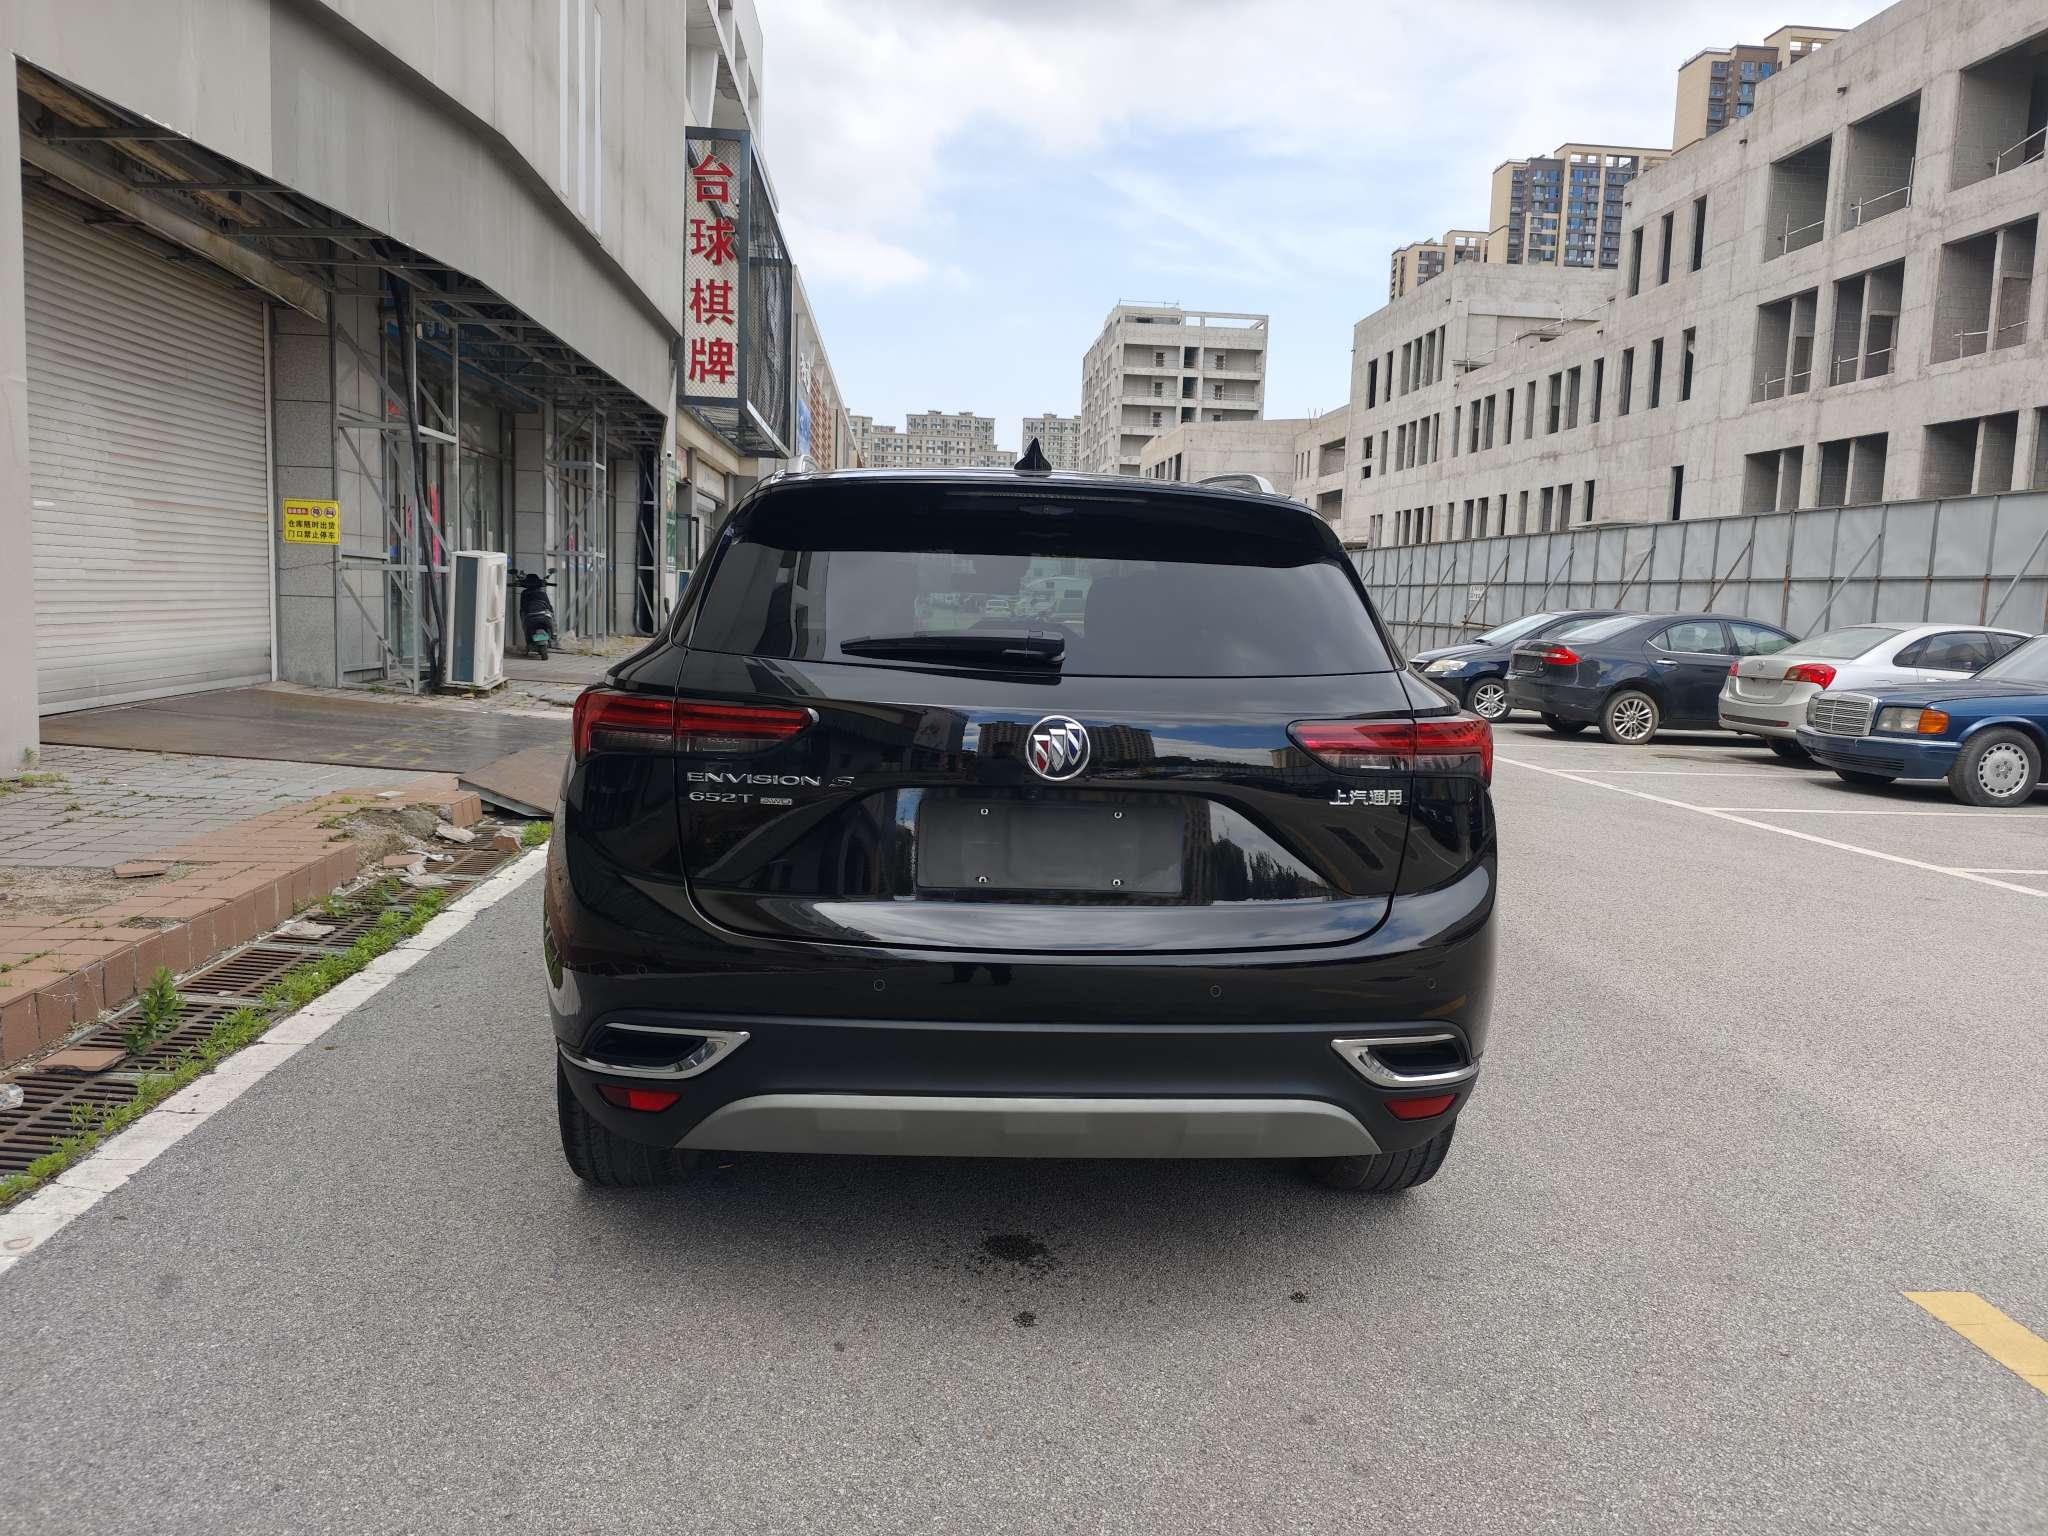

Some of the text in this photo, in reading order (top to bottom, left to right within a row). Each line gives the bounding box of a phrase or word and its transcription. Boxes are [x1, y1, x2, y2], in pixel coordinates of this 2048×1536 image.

[689, 154, 735, 383] 台球棋牌
[288, 520, 336, 530] 仓库随时出货
[288, 530, 336, 540] 门口禁止停车
[687, 772, 855, 788] ENVISION S
[689, 791, 753, 803] 652T
[1329, 789, 1402, 805] 上汽通用
